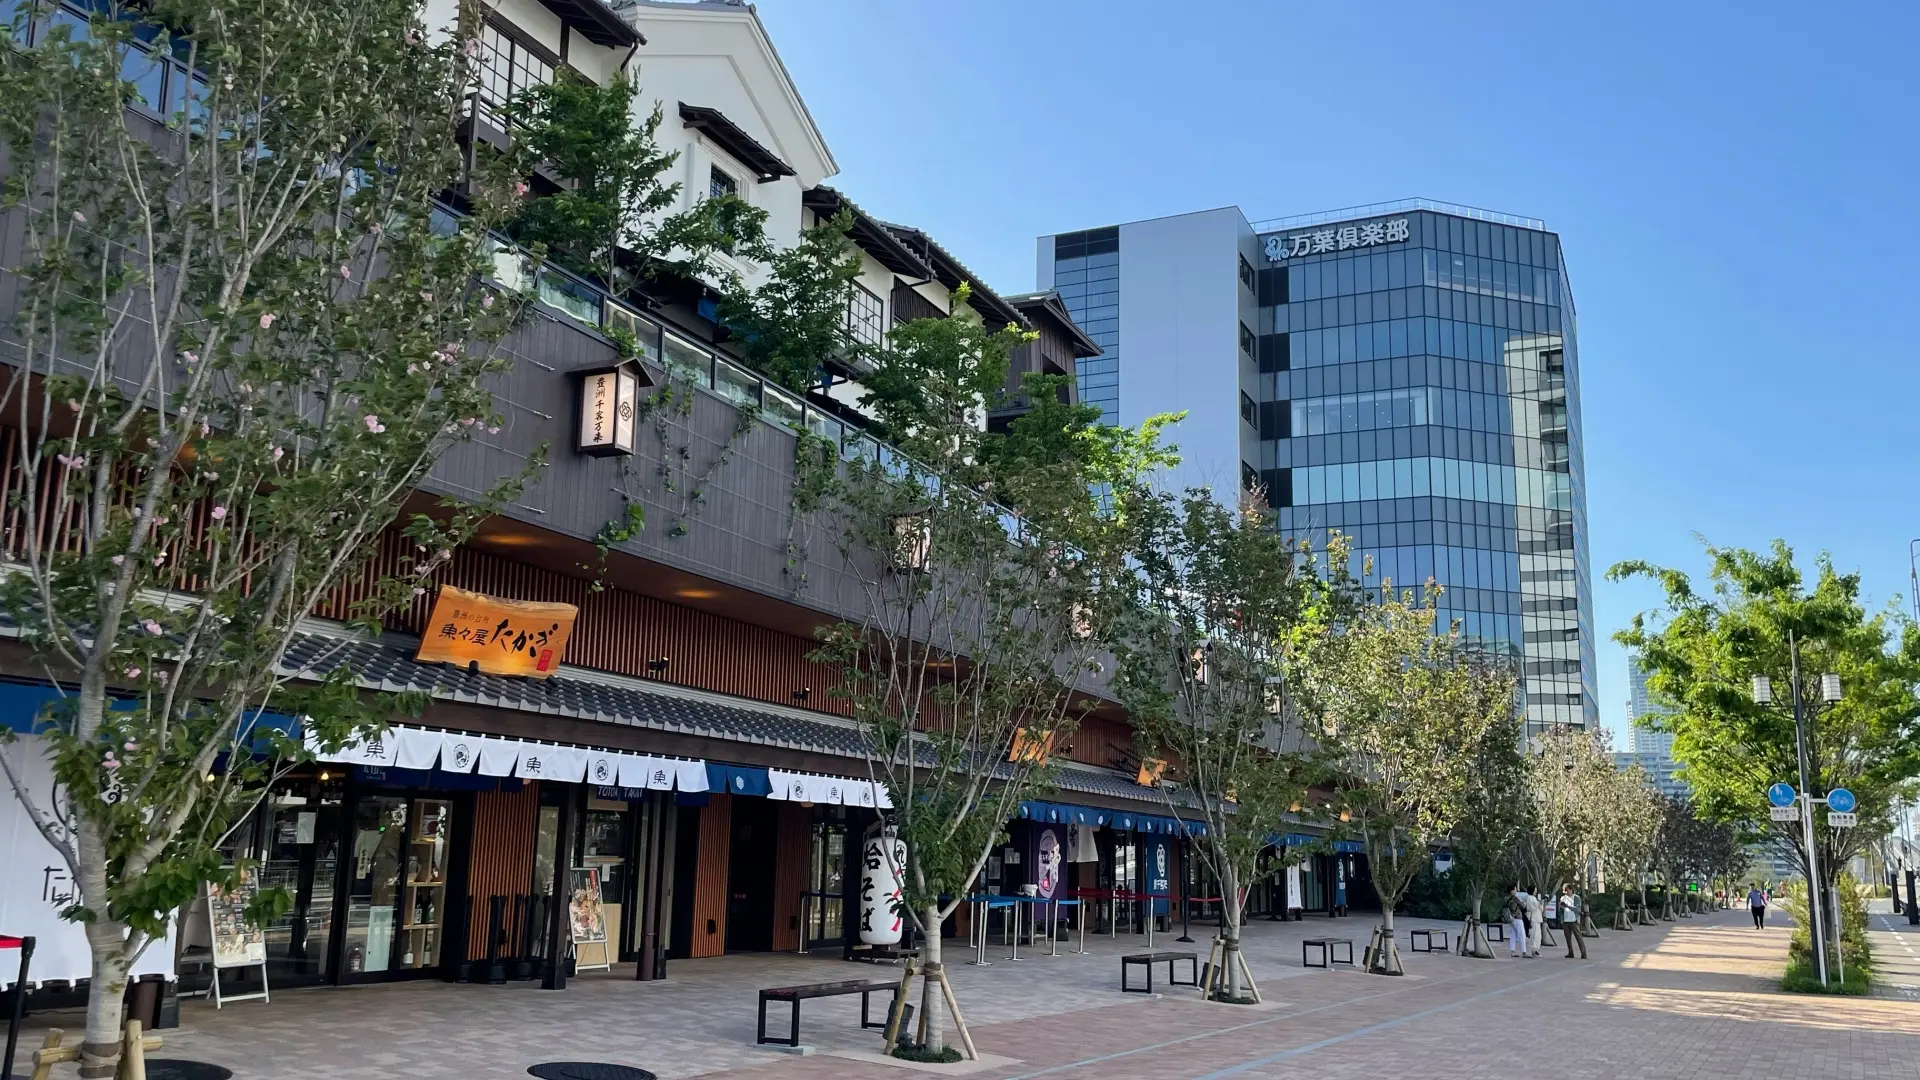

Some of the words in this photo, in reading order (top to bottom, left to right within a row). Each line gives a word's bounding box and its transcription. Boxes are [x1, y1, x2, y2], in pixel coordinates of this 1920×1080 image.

[593, 376, 606, 443] 豊洲千客万来
[363, 741, 386, 759] 魚
[525, 756, 541, 774] 魚
[653, 769, 668, 785] 魚
[829, 786, 840, 799] 魚
